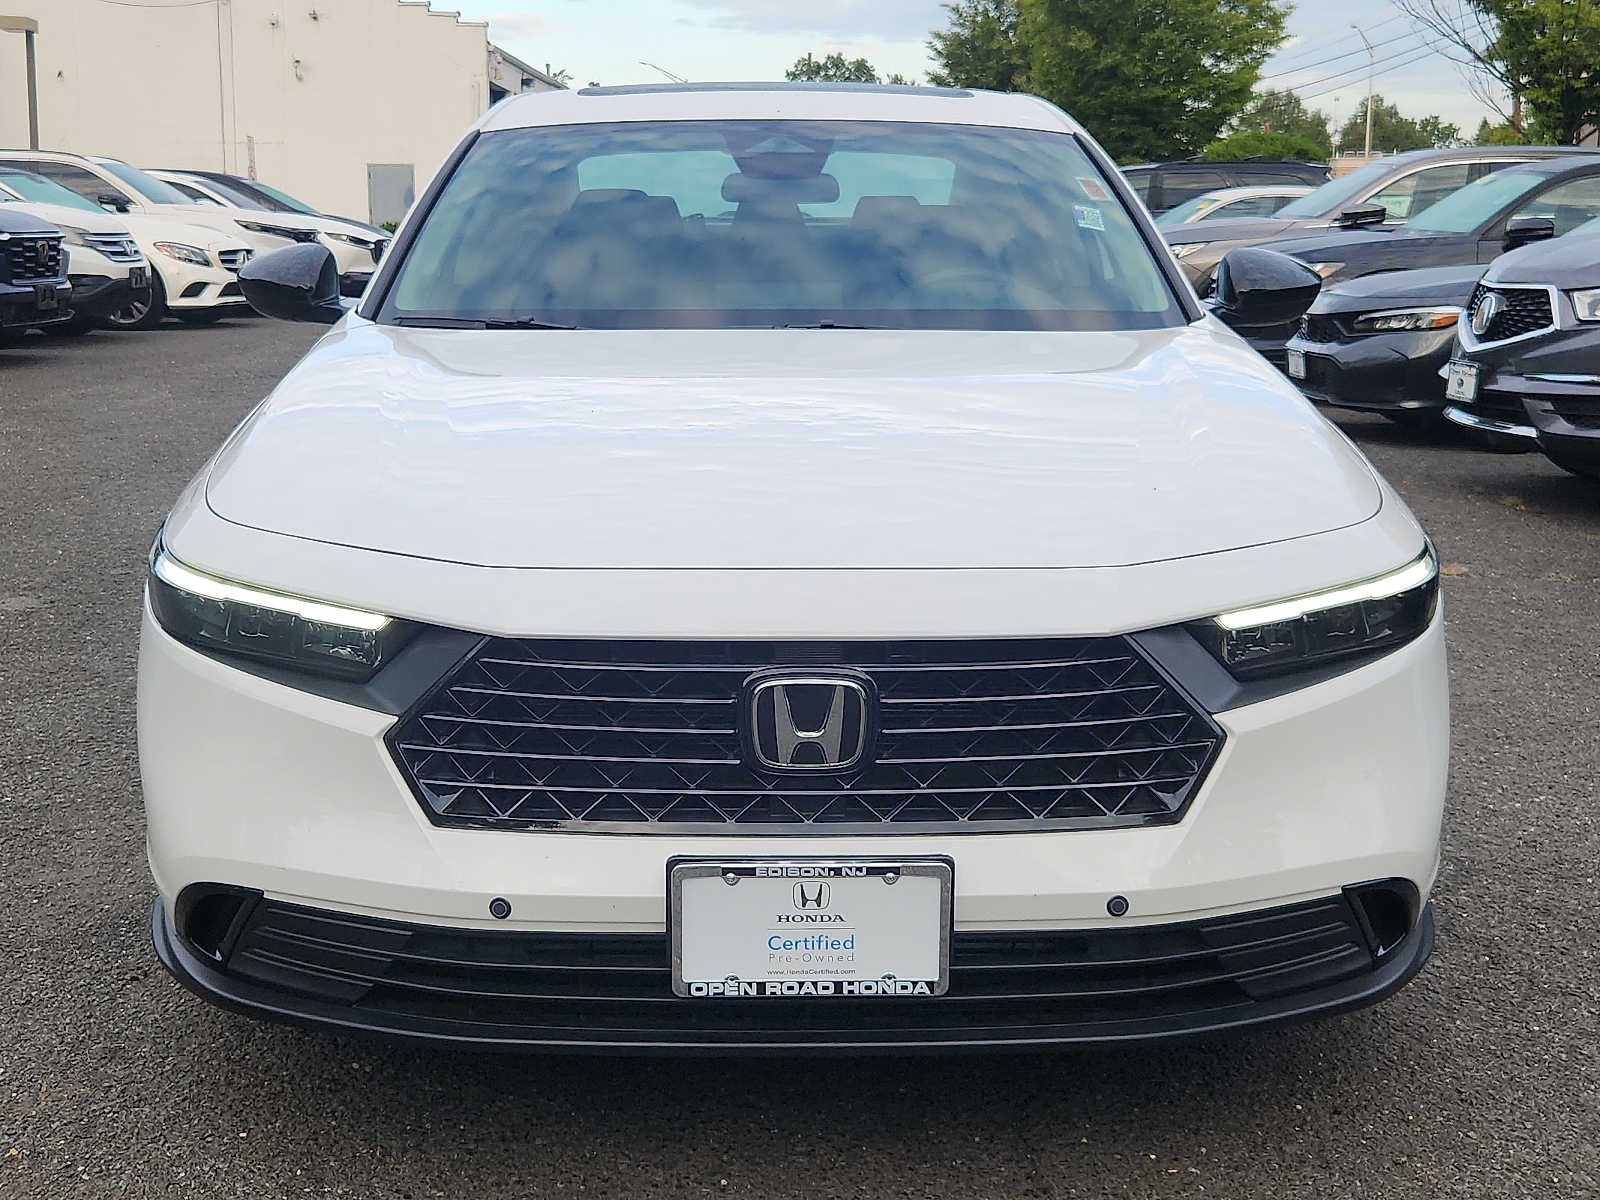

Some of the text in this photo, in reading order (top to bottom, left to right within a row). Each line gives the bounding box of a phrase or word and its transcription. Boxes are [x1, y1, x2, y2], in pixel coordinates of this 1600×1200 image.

[755, 866, 867, 877] EDISON, NJ
[776, 914, 845, 923] HONDA
[767, 934, 855, 951] Certified
[768, 952, 855, 963] Pre-Owned
[766, 968, 856, 976] www.HondaCertified.com
[690, 981, 931, 996] OPEN ROAD HONDA
